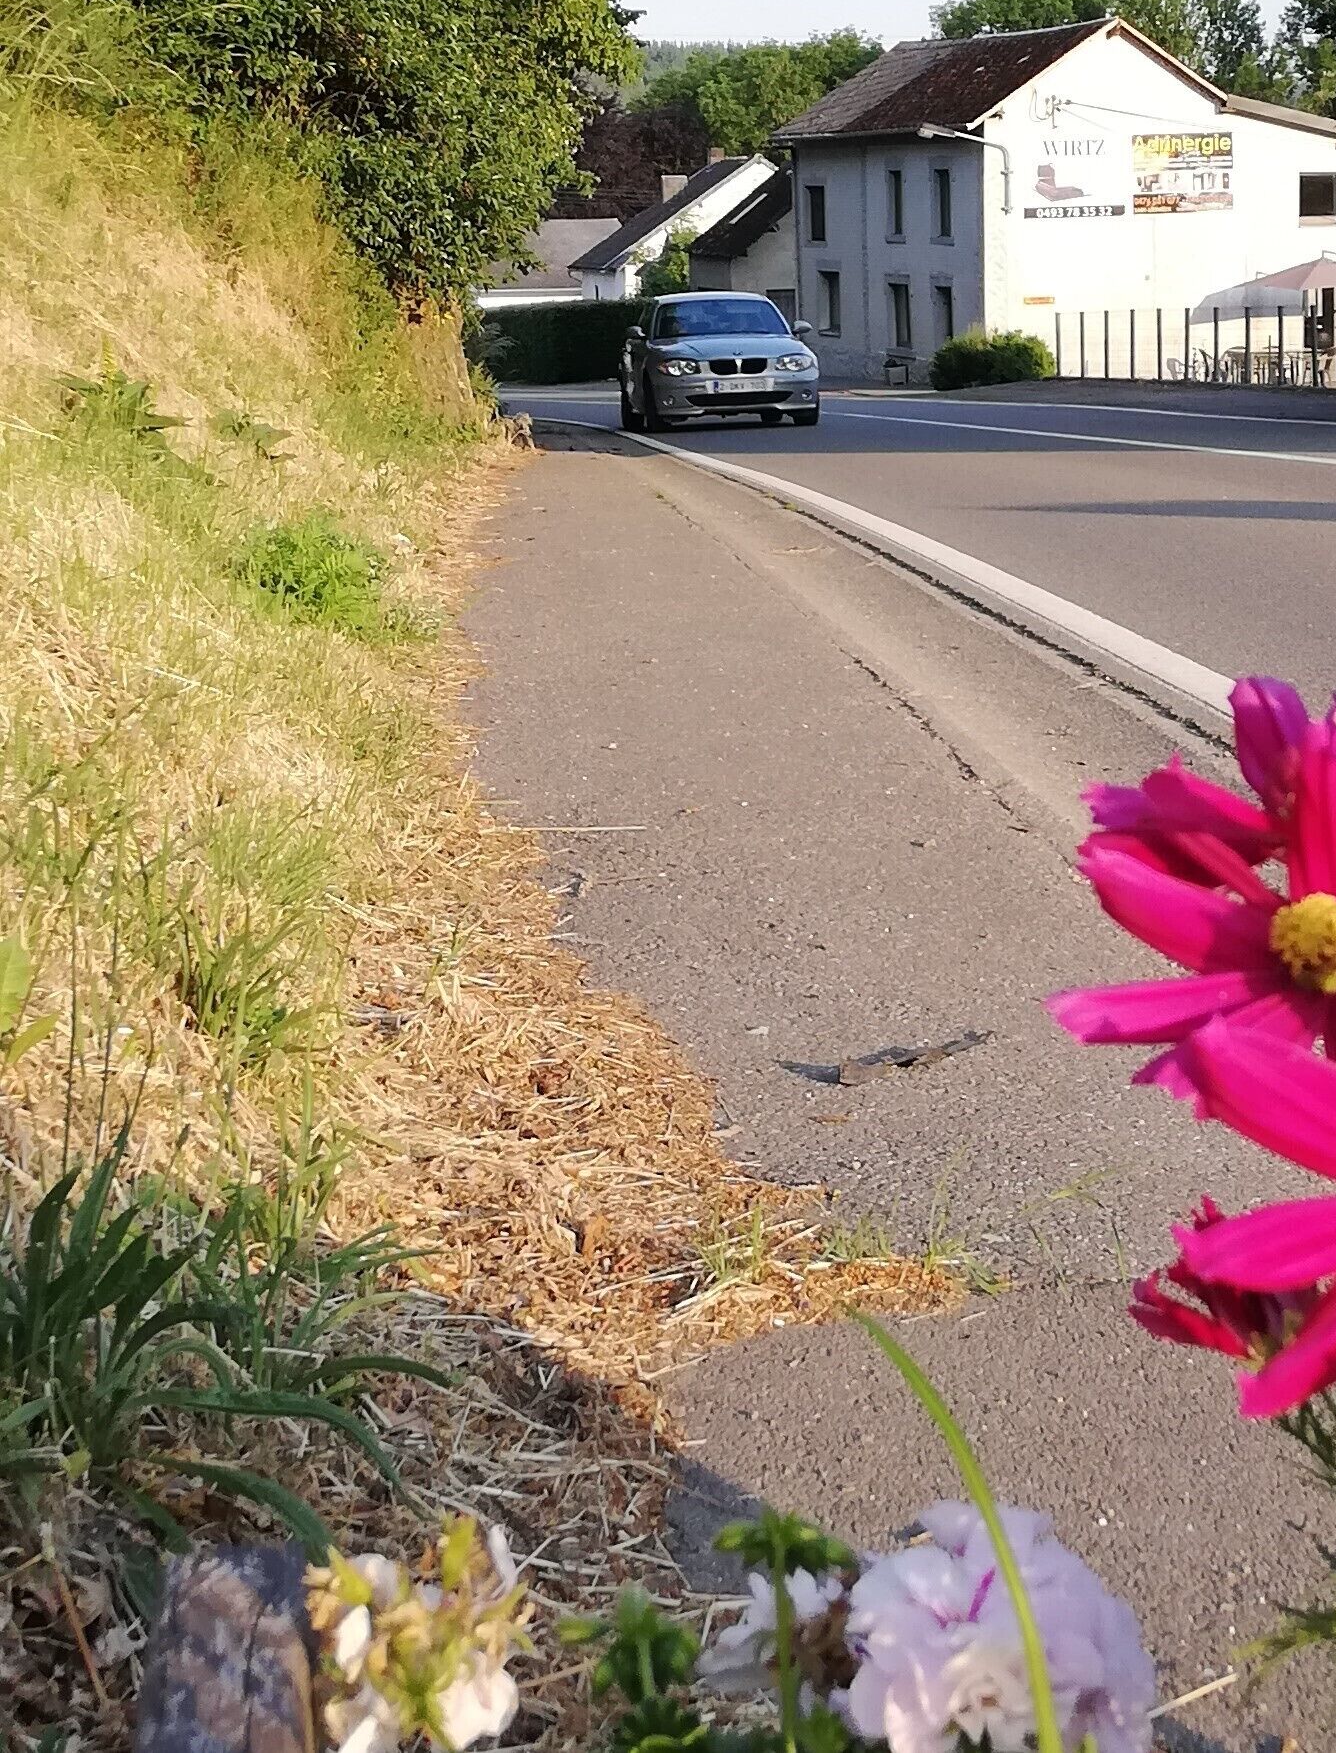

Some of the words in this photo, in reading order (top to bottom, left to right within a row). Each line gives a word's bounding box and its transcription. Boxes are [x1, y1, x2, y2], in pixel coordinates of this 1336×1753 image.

[1043, 139, 1106, 156] WIRTZ
[1036, 207, 1064, 218] 0493
[1098, 206, 1112, 216] 32
